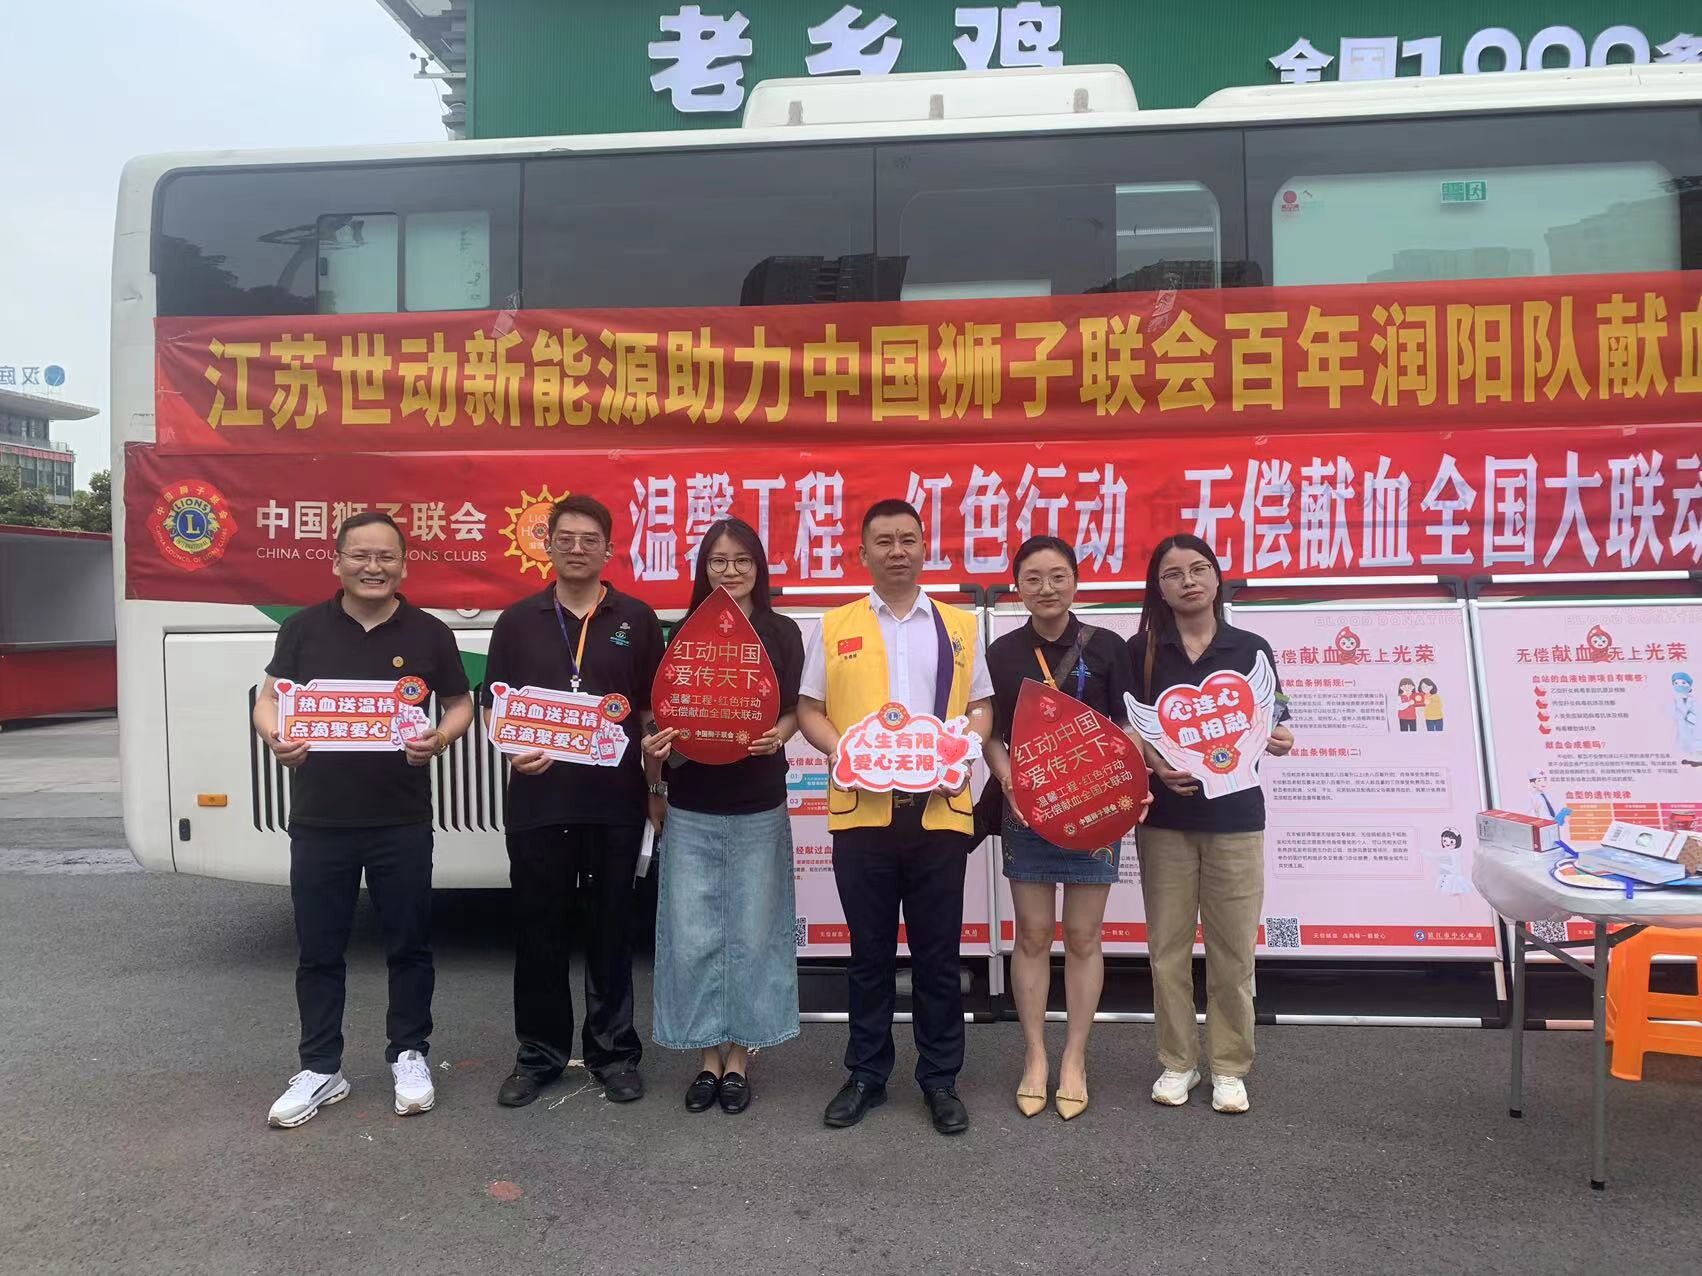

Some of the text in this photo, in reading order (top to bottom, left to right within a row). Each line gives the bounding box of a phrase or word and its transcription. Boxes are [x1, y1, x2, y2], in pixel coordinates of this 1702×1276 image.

[648, 1, 1063, 112] 老乡鸡
[174, 498, 211, 513] LIONS
[185, 514, 201, 534] L
[629, 469, 845, 581] 温馨工程
[906, 463, 1128, 574] 红色行动
[256, 547, 300, 560] CHINA
[405, 549, 439, 562] IONS
[444, 550, 487, 562] CLUBS
[673, 640, 761, 664] 红动中国
[1357, 644, 1435, 663] 无上光荣
[1517, 642, 1688, 663] 无偿献血 无上光荣
[672, 665, 760, 689] 爱传天下
[298, 697, 396, 714] 热血送温情
[508, 700, 599, 728] 热血送温情
[667, 706, 762, 721] 无偿献血全国大联动
[1169, 688, 1240, 721] 心连心
[290, 720, 388, 738] 点滴聚爱心
[499, 722, 589, 750] 点滴聚爱心
[853, 732, 935, 749] 人生有限
[1014, 710, 1101, 766] 红动中国
[1178, 710, 1251, 747] 血相融
[853, 754, 935, 772] 爱心无限
[1025, 733, 1109, 790] 爱传天下
[1040, 770, 1133, 820] 无偿献血全国大联动
